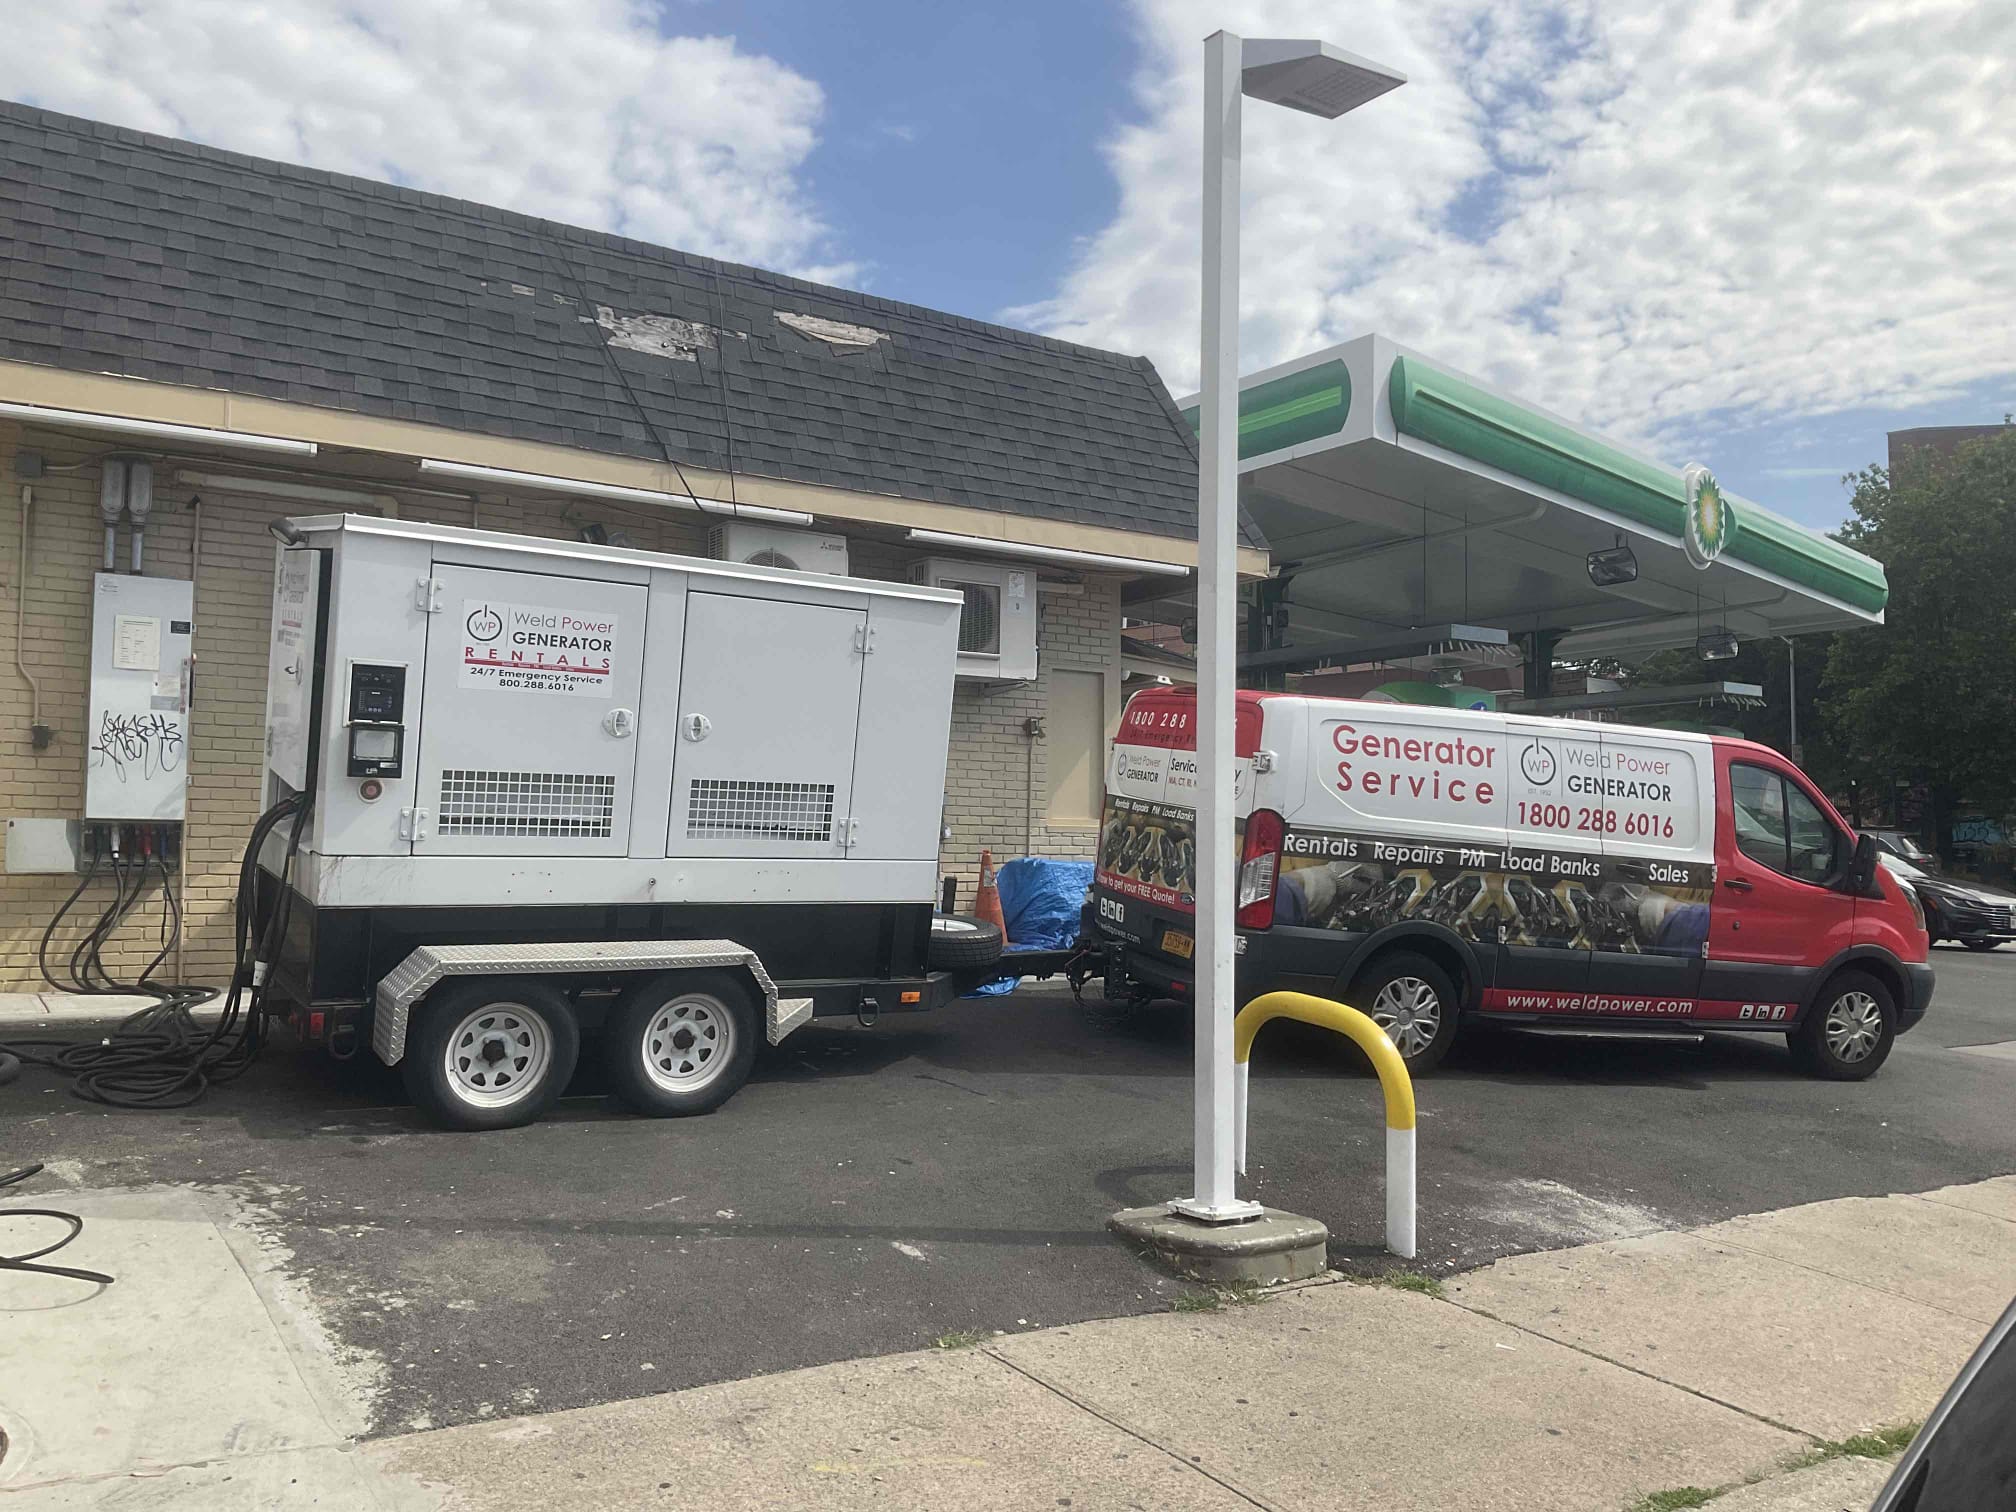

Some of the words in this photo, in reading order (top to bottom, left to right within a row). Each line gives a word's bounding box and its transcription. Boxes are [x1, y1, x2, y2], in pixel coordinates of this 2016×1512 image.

[474, 621, 496, 633] WP
[514, 611, 556, 629] Weld
[561, 616, 614, 634] Power
[512, 631, 612, 652] GENERATOR
[465, 646, 610, 669] RENTALS
[470, 667, 495, 677] 24/7
[498, 669, 561, 682] Emergency
[564, 674, 603, 684] Service
[499, 679, 574, 692] 800.288.6016
[1130, 711, 1155, 727] 1800
[1160, 712, 1187, 729] 288
[1332, 724, 1496, 769] Generator
[1528, 759, 1550, 774] WP
[1566, 747, 1611, 769] Weld
[1616, 753, 1671, 777] Power
[1127, 769, 1159, 782] GENERATOR
[1336, 761, 1494, 805] Service
[1567, 775, 1672, 802] GENERATOR
[1132, 802, 1149, 813] Repairs
[1162, 807, 1176, 818] Load
[1176, 809, 1194, 821] Banks
[1518, 801, 1571, 829] 1800
[1576, 807, 1617, 833] 288
[1625, 812, 1674, 838] 6016
[1283, 833, 1359, 858] Rentals
[1373, 841, 1445, 867] Repairs
[1459, 847, 1486, 868] PM
[1500, 850, 1546, 874] Load
[1550, 854, 1600, 877] Banks
[1648, 863, 1690, 884] Sales
[1124, 882, 1137, 893] your
[1137, 884, 1151, 898] FREE
[1151, 888, 1175, 904] Quote!
[1507, 993, 1693, 1014] www.weldpower.com
